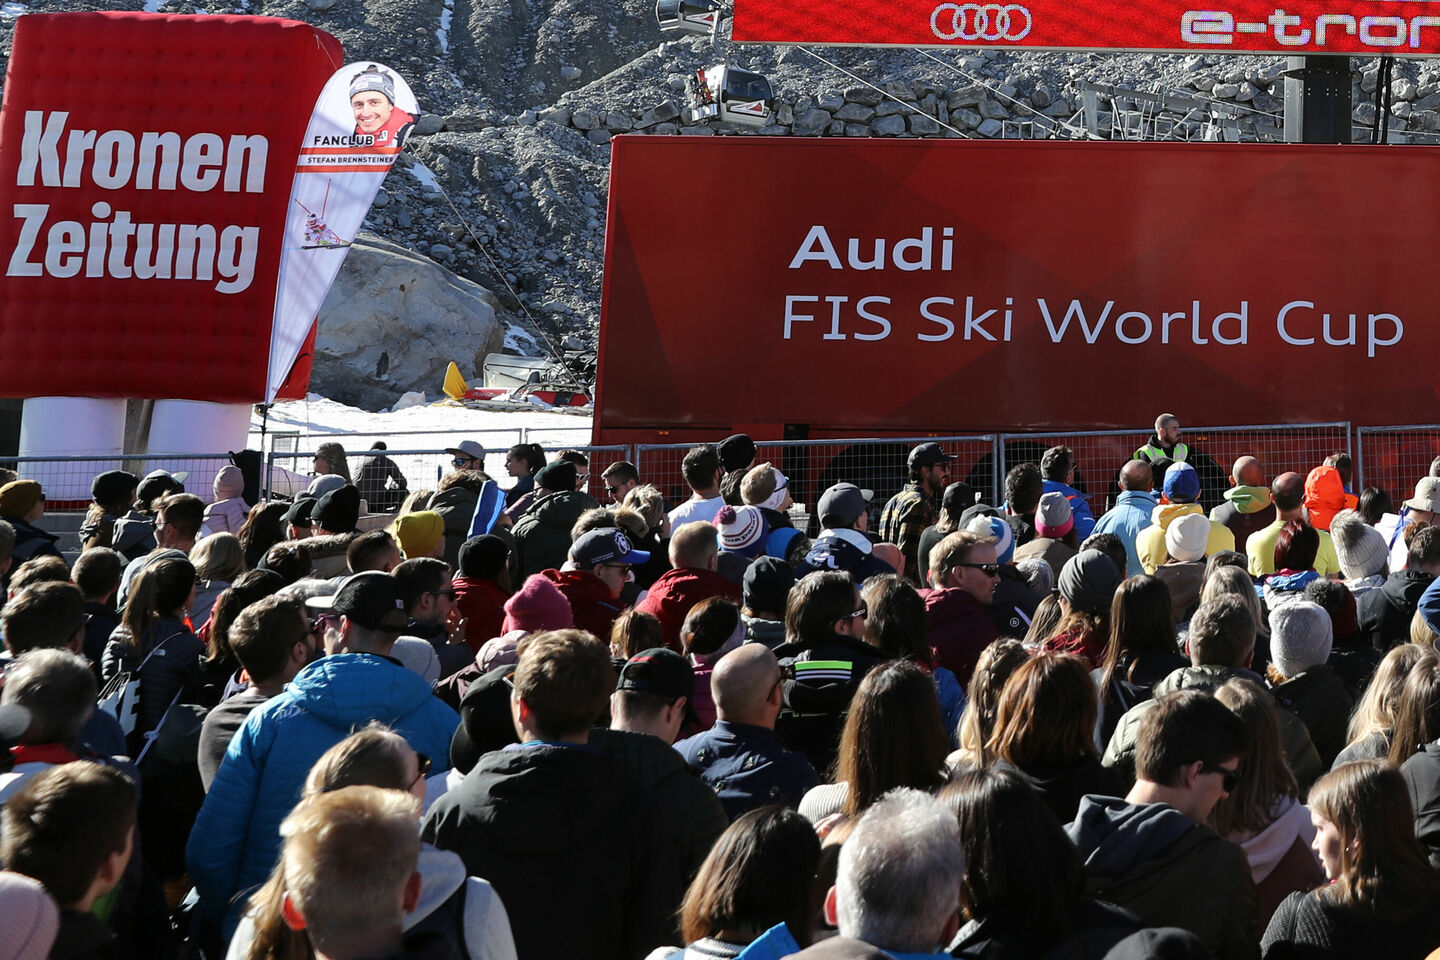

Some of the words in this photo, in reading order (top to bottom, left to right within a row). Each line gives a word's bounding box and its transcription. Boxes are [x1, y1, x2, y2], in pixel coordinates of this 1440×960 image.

[16, 110, 269, 193] Kronen
[313, 136, 374, 146] FANCLUB
[6, 201, 260, 294] Zeitung
[789, 225, 954, 271] Audi
[784, 295, 891, 341] FIS
[918, 296, 1012, 342] Ski
[1037, 298, 1248, 345] World
[1277, 300, 1404, 357] Cup
